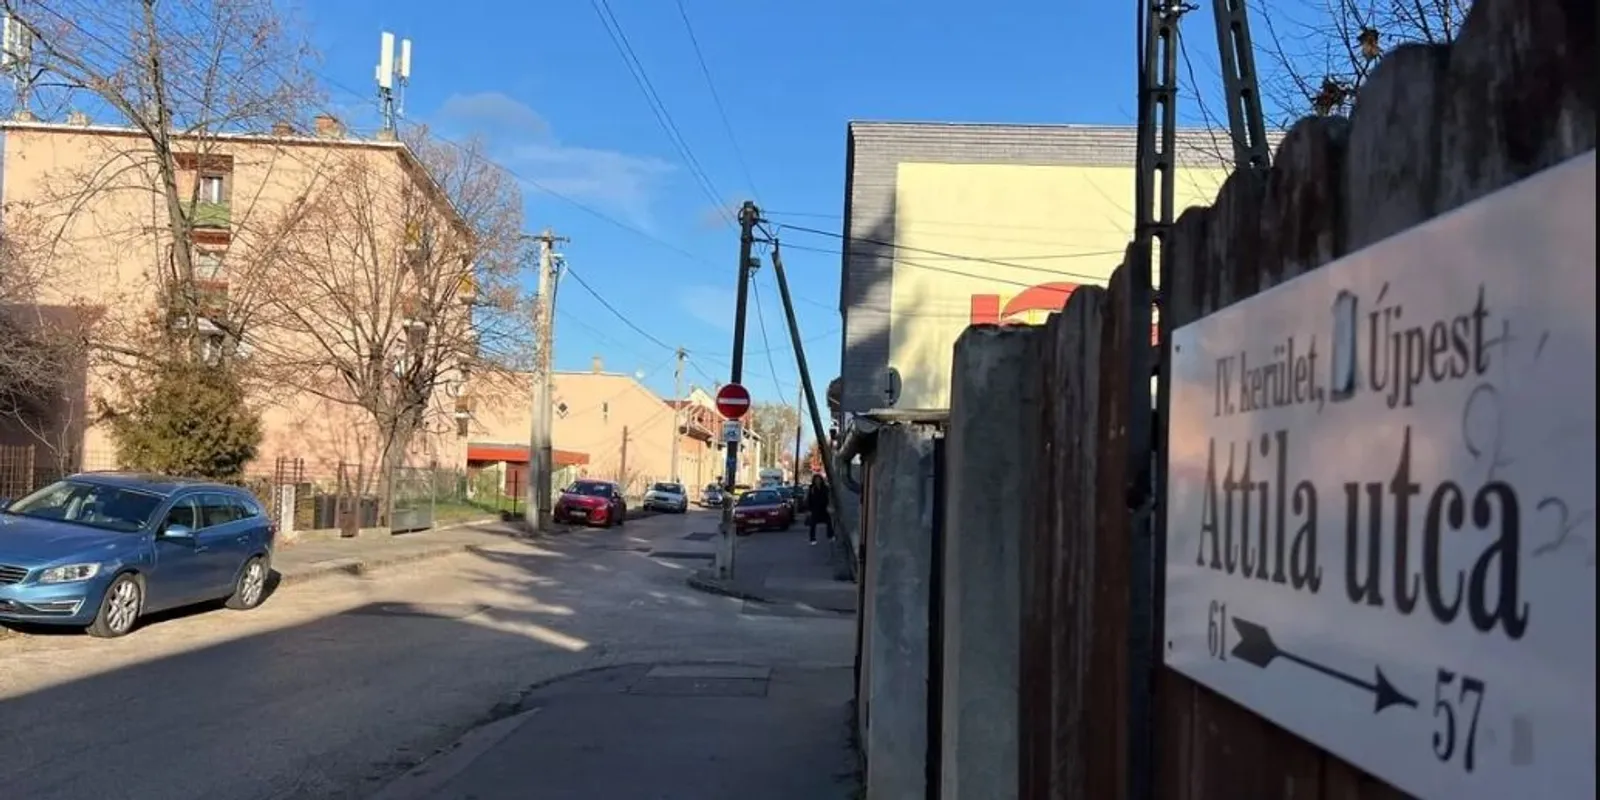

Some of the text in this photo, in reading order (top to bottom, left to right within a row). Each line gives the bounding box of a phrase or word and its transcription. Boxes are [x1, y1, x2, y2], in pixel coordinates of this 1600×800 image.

[1214, 281, 1489, 418] IV. kerület, Újpest
[1196, 429, 1322, 594] Attila
[1343, 425, 1530, 641] utca
[1207, 601, 1486, 773] 61 57
